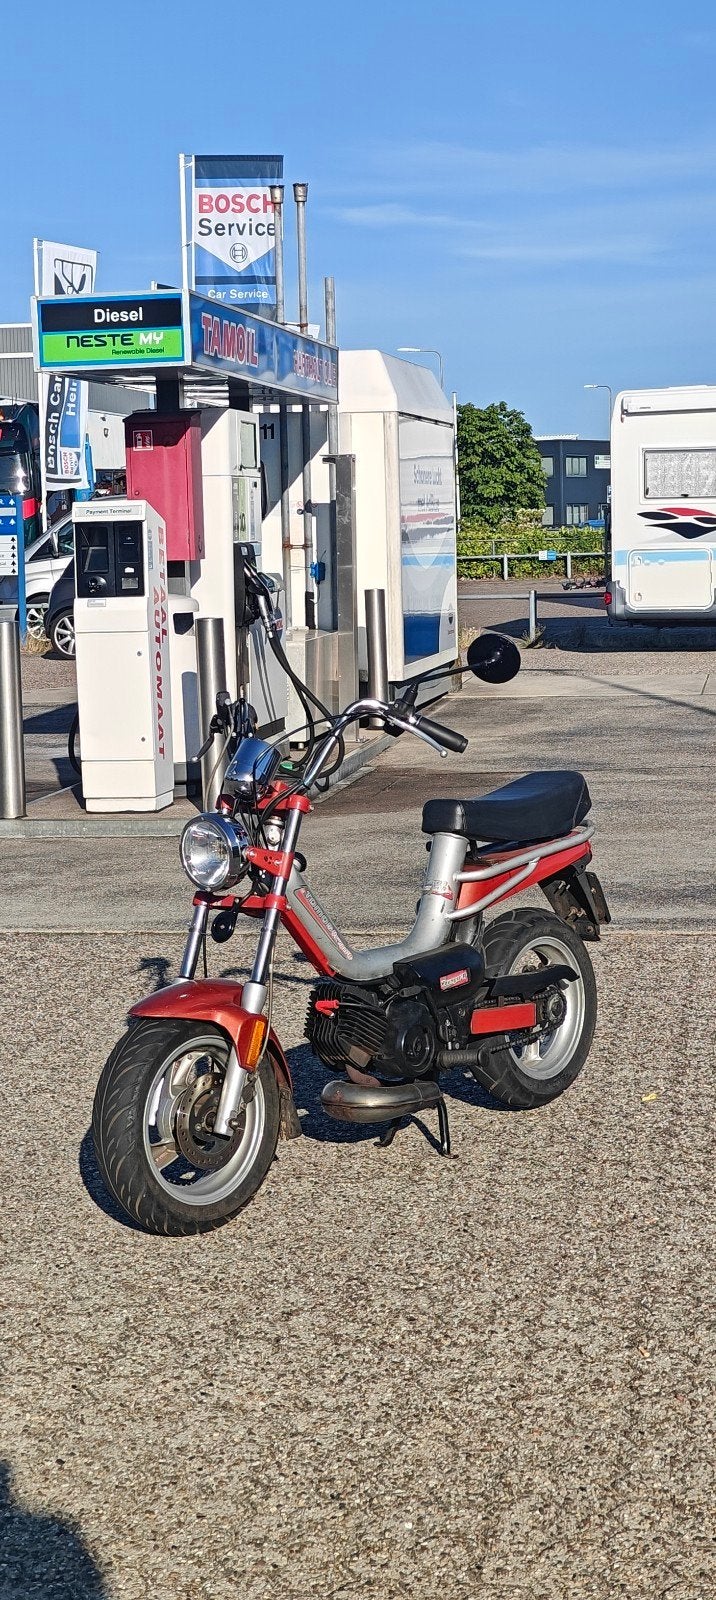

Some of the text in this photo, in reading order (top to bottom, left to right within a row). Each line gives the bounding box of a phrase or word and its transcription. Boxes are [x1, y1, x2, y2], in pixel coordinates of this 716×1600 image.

[198, 193, 274, 214] BOSCH
[197, 217, 276, 237] Service
[208, 288, 269, 299] Car Service
[93, 306, 143, 323] Diesel
[66, 331, 164, 348] NESTE MY
[201, 312, 259, 368] TAMOIL
[50, 375, 63, 406] Car
[259, 423, 275, 440] 11
[157, 526, 168, 644] BETAAL
[153, 586, 165, 760] AUTOMAAT
